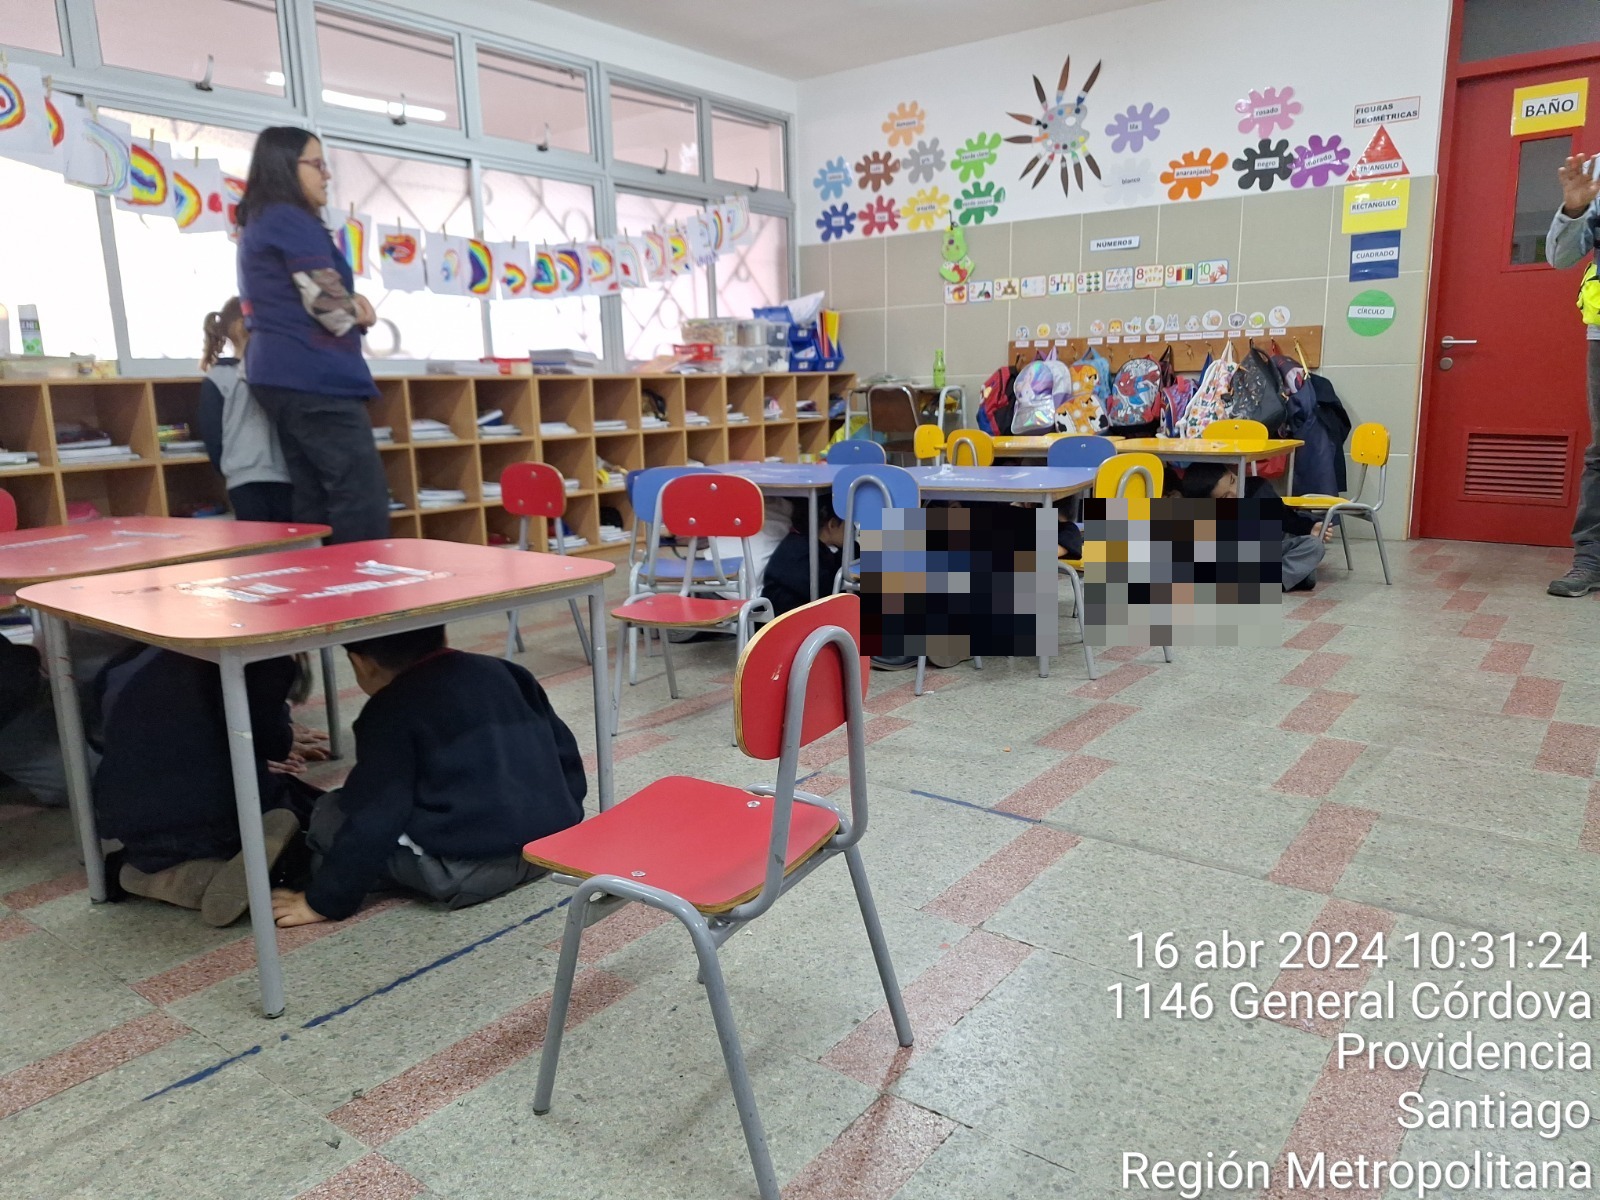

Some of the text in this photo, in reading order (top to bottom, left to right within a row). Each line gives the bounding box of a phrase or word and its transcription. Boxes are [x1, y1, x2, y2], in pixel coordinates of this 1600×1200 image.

[1256, 107, 1278, 116] rosado
[1356, 103, 1394, 114] FIGURAS
[1525, 97, 1574, 117] BAÑO
[1355, 110, 1418, 125] GEOMÉTRICAS
[1257, 160, 1276, 169] negro
[1175, 168, 1211, 177] anaranjado
[1352, 200, 1397, 211] RECTANGULO
[1096, 239, 1132, 248] NÚMEROS
[1356, 250, 1395, 260] CUADRADO
[1136, 268, 1144, 280] 8
[1166, 266, 1174, 278] 9
[1199, 264, 1211, 276] 10
[1050, 276, 1056, 286] 5
[1078, 275, 1084, 284] 6
[1107, 272, 1114, 282] 7
[1022, 280, 1028, 288] 4
[1357, 306, 1386, 315] CÍRCULO
